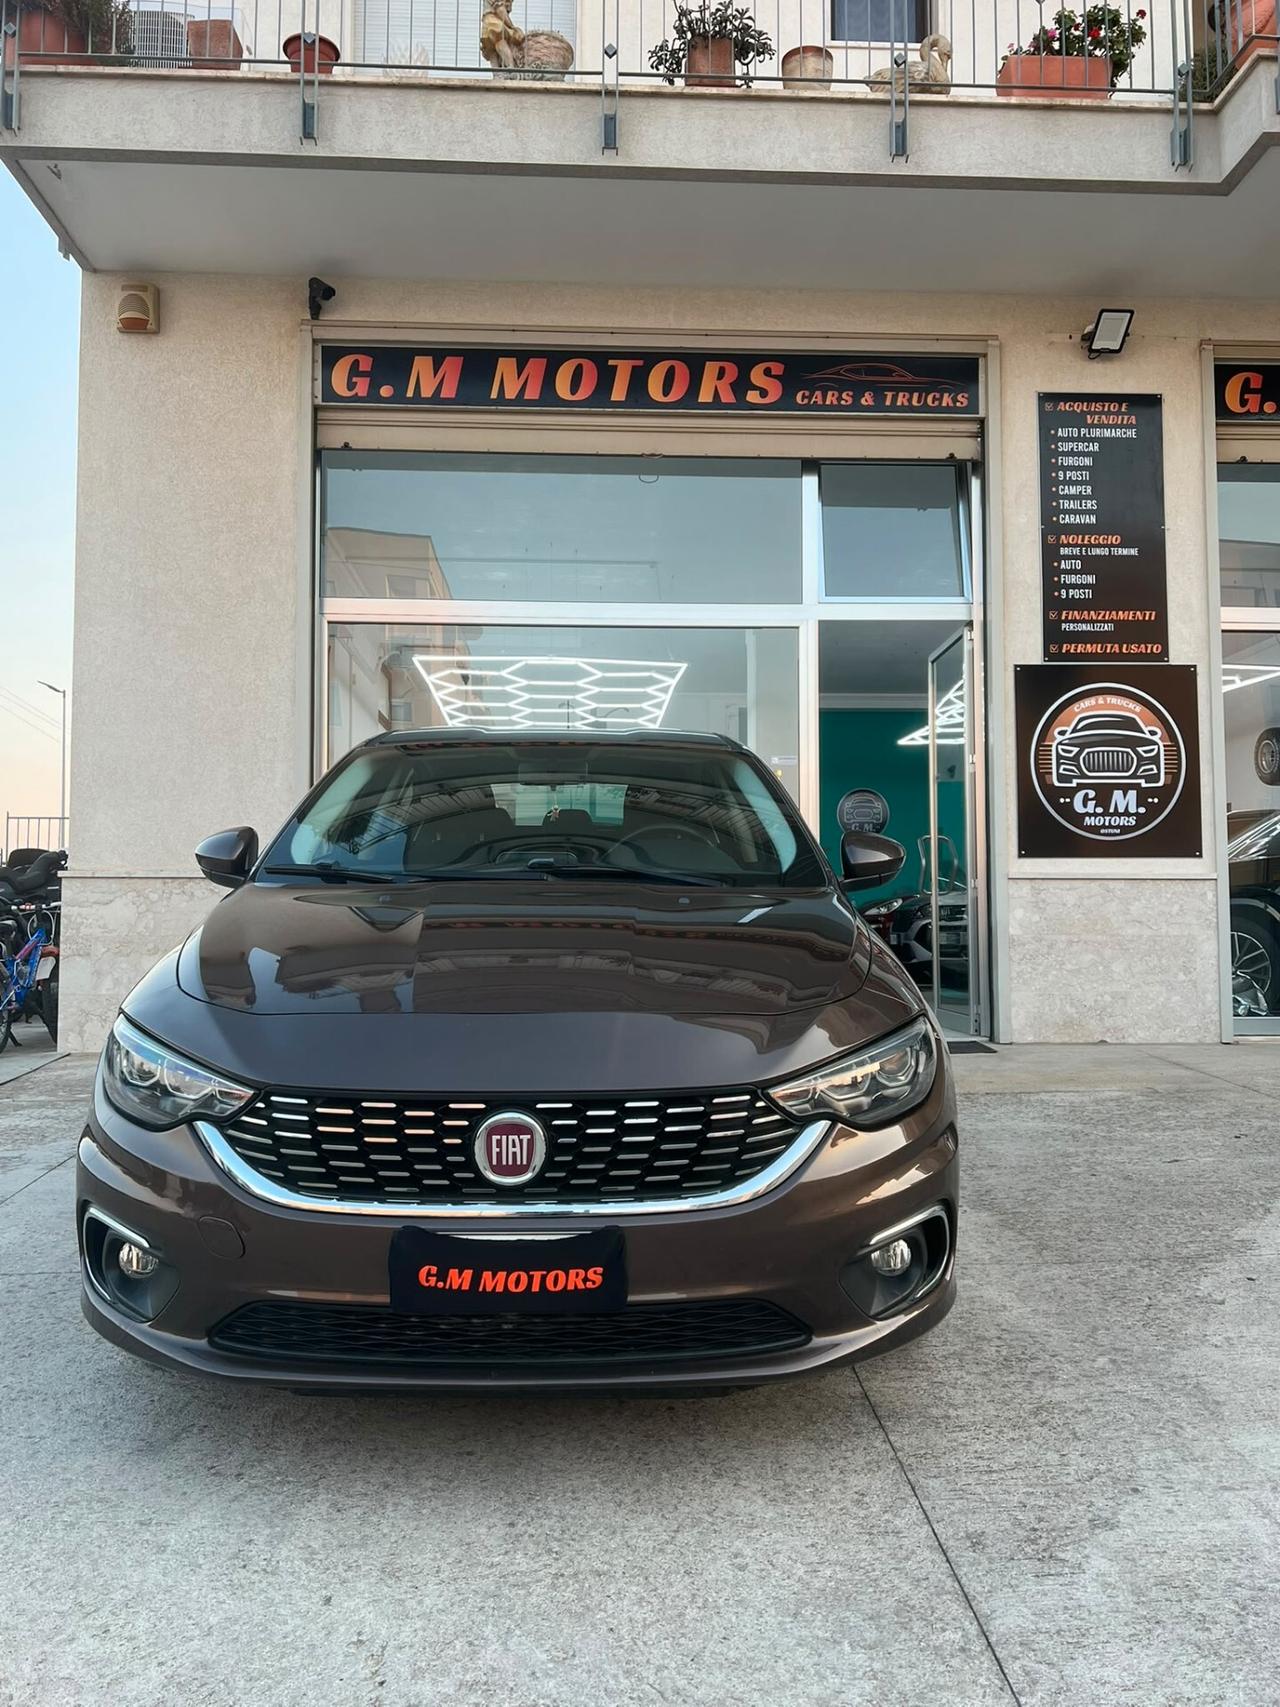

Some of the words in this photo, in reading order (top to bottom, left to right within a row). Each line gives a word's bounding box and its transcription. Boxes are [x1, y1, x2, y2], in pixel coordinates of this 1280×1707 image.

[330, 354, 464, 398] G.M
[489, 357, 785, 404] MOTORS
[796, 389, 853, 407] CARS
[860, 391, 875, 407] &
[884, 391, 969, 408] TRUCKS
[1057, 401, 1119, 413] ACQUISTO
[1121, 402, 1129, 412] E
[1086, 414, 1137, 425] VENDITA
[1057, 427, 1078, 438] AUTO
[1080, 428, 1137, 438] PLURIMARCHE
[1057, 442, 1099, 452] SUPERCAR
[1058, 456, 1093, 466] FURGONI
[1058, 470, 1064, 480] 9
[1066, 471, 1090, 481] POSTI
[1058, 485, 1092, 495] CAMPER
[1059, 499, 1098, 510] TRAILERS
[1059, 514, 1096, 524] CARAVAN
[1059, 534, 1121, 545] NOLEGGIO
[1060, 547, 1081, 555] BREVE
[1082, 547, 1087, 555] E
[1088, 547, 1109, 556] LUNGO
[1110, 547, 1139, 556] TERMINE
[1060, 559, 1082, 570] AUTO
[1060, 574, 1096, 585] FURGONI
[1060, 589, 1067, 599] 9
[1068, 589, 1093, 599] POSTI
[1061, 610, 1156, 620] FINANZIAMENTI
[1061, 623, 1114, 632] PERSONALIZZATI
[1061, 643, 1120, 654] PERMUTA
[1122, 643, 1162, 654] USATO
[1074, 699, 1097, 713] CARS
[1098, 696, 1105, 705] &
[1083, 815, 1137, 827] MOTORS
[492, 1134, 532, 1166] FIAT
[418, 1265, 473, 1290] G.M
[478, 1266, 604, 1293] MOTORS
